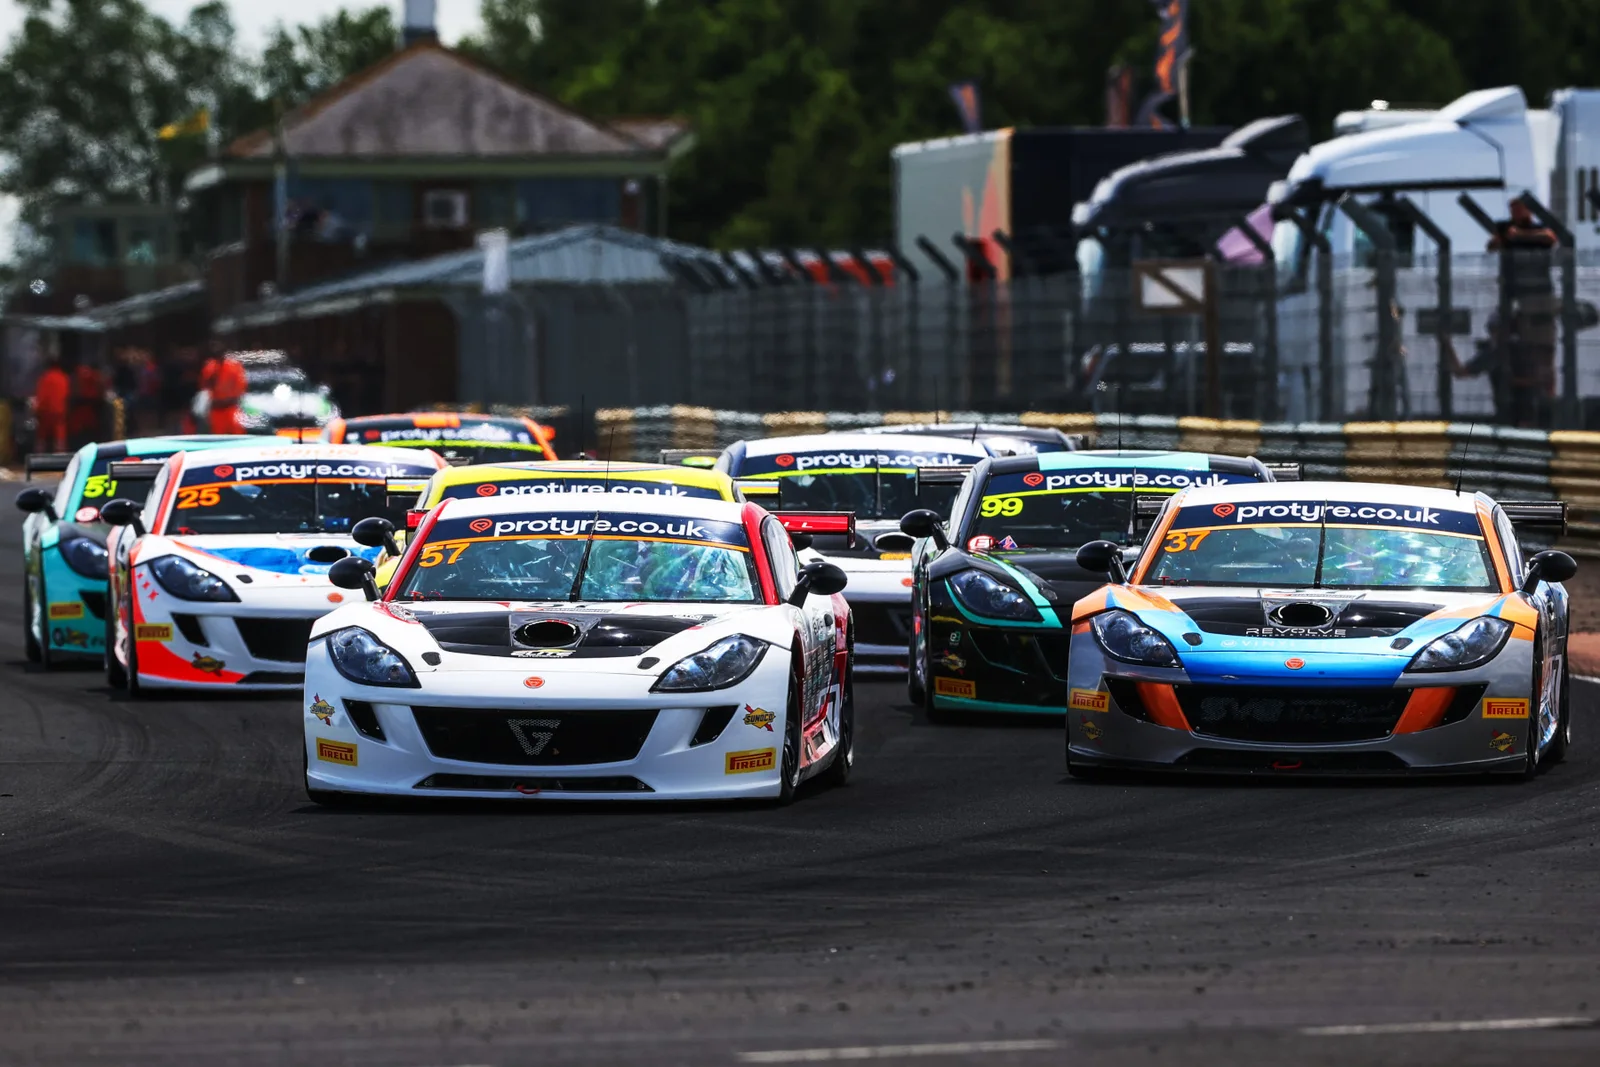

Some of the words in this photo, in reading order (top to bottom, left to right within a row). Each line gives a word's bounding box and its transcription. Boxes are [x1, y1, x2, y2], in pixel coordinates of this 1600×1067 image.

[236, 462, 407, 480] protyre.co.uk
[796, 453, 962, 470] protyre.co.uk
[500, 482, 688, 498] protyre.couk
[1046, 472, 1228, 490] protyre.co.uk
[176, 488, 220, 510] 25
[980, 498, 1023, 518] 99
[1236, 502, 1440, 525] protyre.co.uk
[493, 517, 705, 538] protyre.co.uk
[1164, 530, 1211, 552] 37
[418, 542, 470, 568] 57
[1073, 691, 1106, 709] PIRELLI
[1487, 702, 1525, 716] PIRELLI
[743, 711, 776, 724] SUNOCO
[319, 742, 354, 762] PIRELLI
[729, 751, 773, 771] PIRELLI
